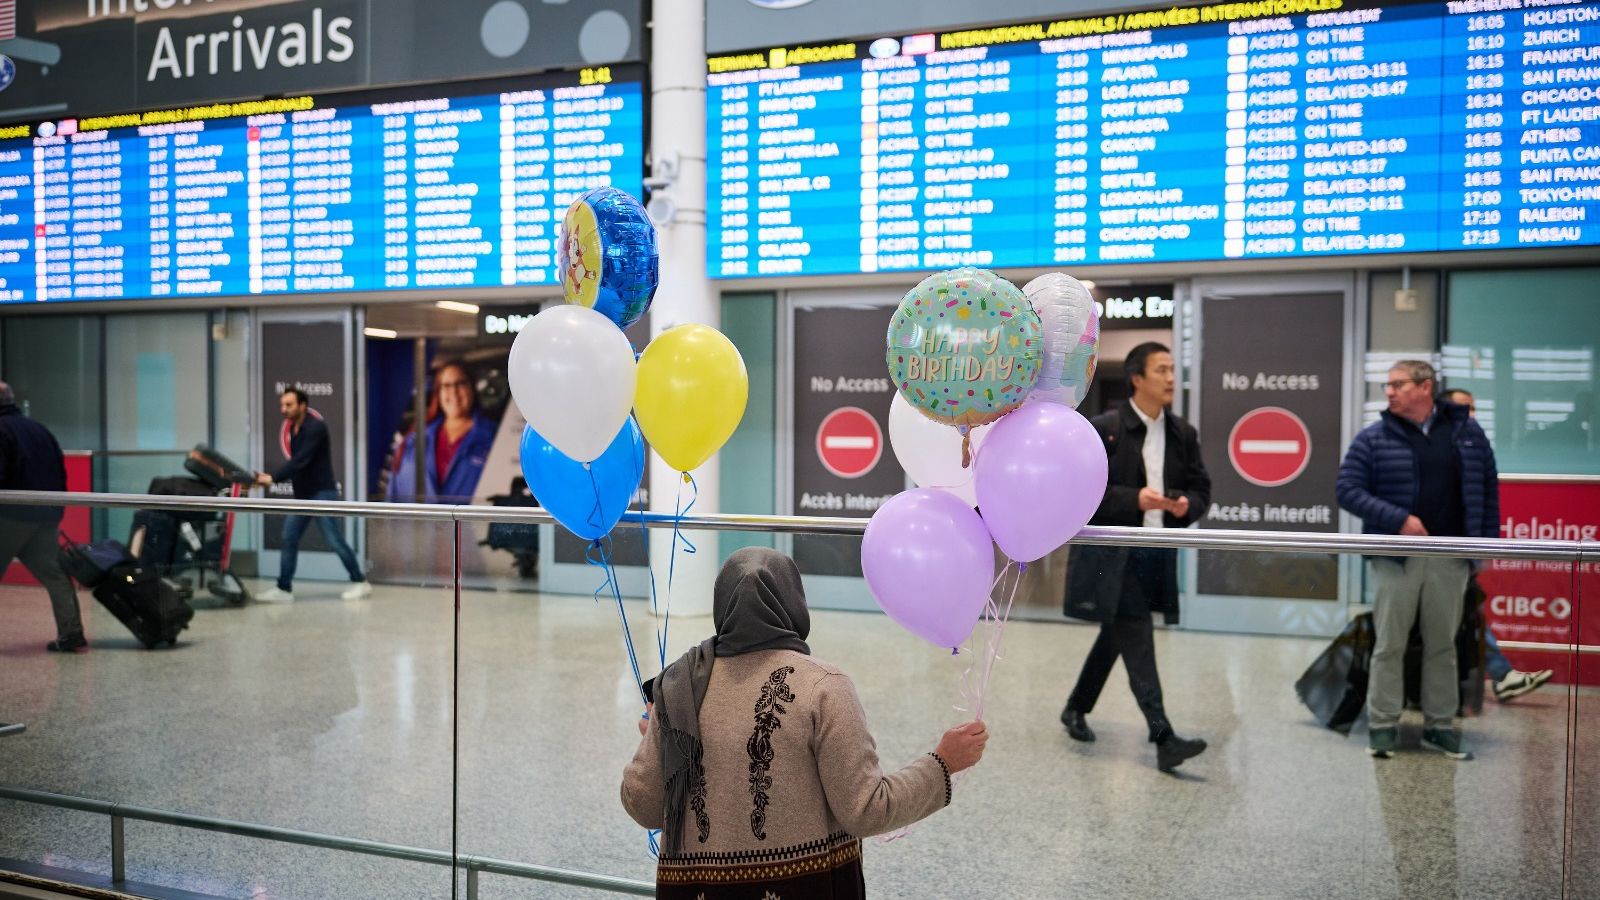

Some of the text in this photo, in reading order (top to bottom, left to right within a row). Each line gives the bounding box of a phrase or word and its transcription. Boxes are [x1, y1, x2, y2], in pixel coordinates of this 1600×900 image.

[1047, 15, 1117, 39] ARRIVALS
[1467, 15, 1506, 31] 16:05
[147, 8, 355, 81] Arrivals
[1307, 27, 1364, 45] ON TIME
[1467, 34, 1505, 51] 16:10
[1523, 28, 1580, 46] ZURICH
[1306, 49, 1329, 64] ON
[1330, 46, 1364, 62] TIME
[1466, 54, 1505, 70] 16:15
[1522, 69, 1554, 86] SAN
[1102, 84, 1128, 101] LOS
[1305, 102, 1363, 121] ON TIME
[1521, 109, 1541, 125] FT
[1305, 122, 1363, 139] ON TIME
[1520, 127, 1582, 145] ATHENS
[1520, 148, 1571, 166] PUNTA
[1520, 168, 1553, 185] SAN
[1463, 210, 1502, 226] 17:10
[1519, 206, 1585, 224] RALEIGH
[1303, 218, 1325, 233] ON
[1326, 216, 1361, 231] TIME
[1519, 226, 1582, 244] NASSAU
[1106, 297, 1143, 319] Not
[485, 314, 507, 334] Do
[921, 326, 1000, 355] HAPPY
[907, 354, 1015, 383] BIRTHDAY
[811, 376, 889, 393] No Access
[1222, 372, 1320, 391] No Access
[800, 491, 843, 509] Accès
[1207, 502, 1331, 525] Accès interdit
[1490, 595, 1546, 618] CIBC
